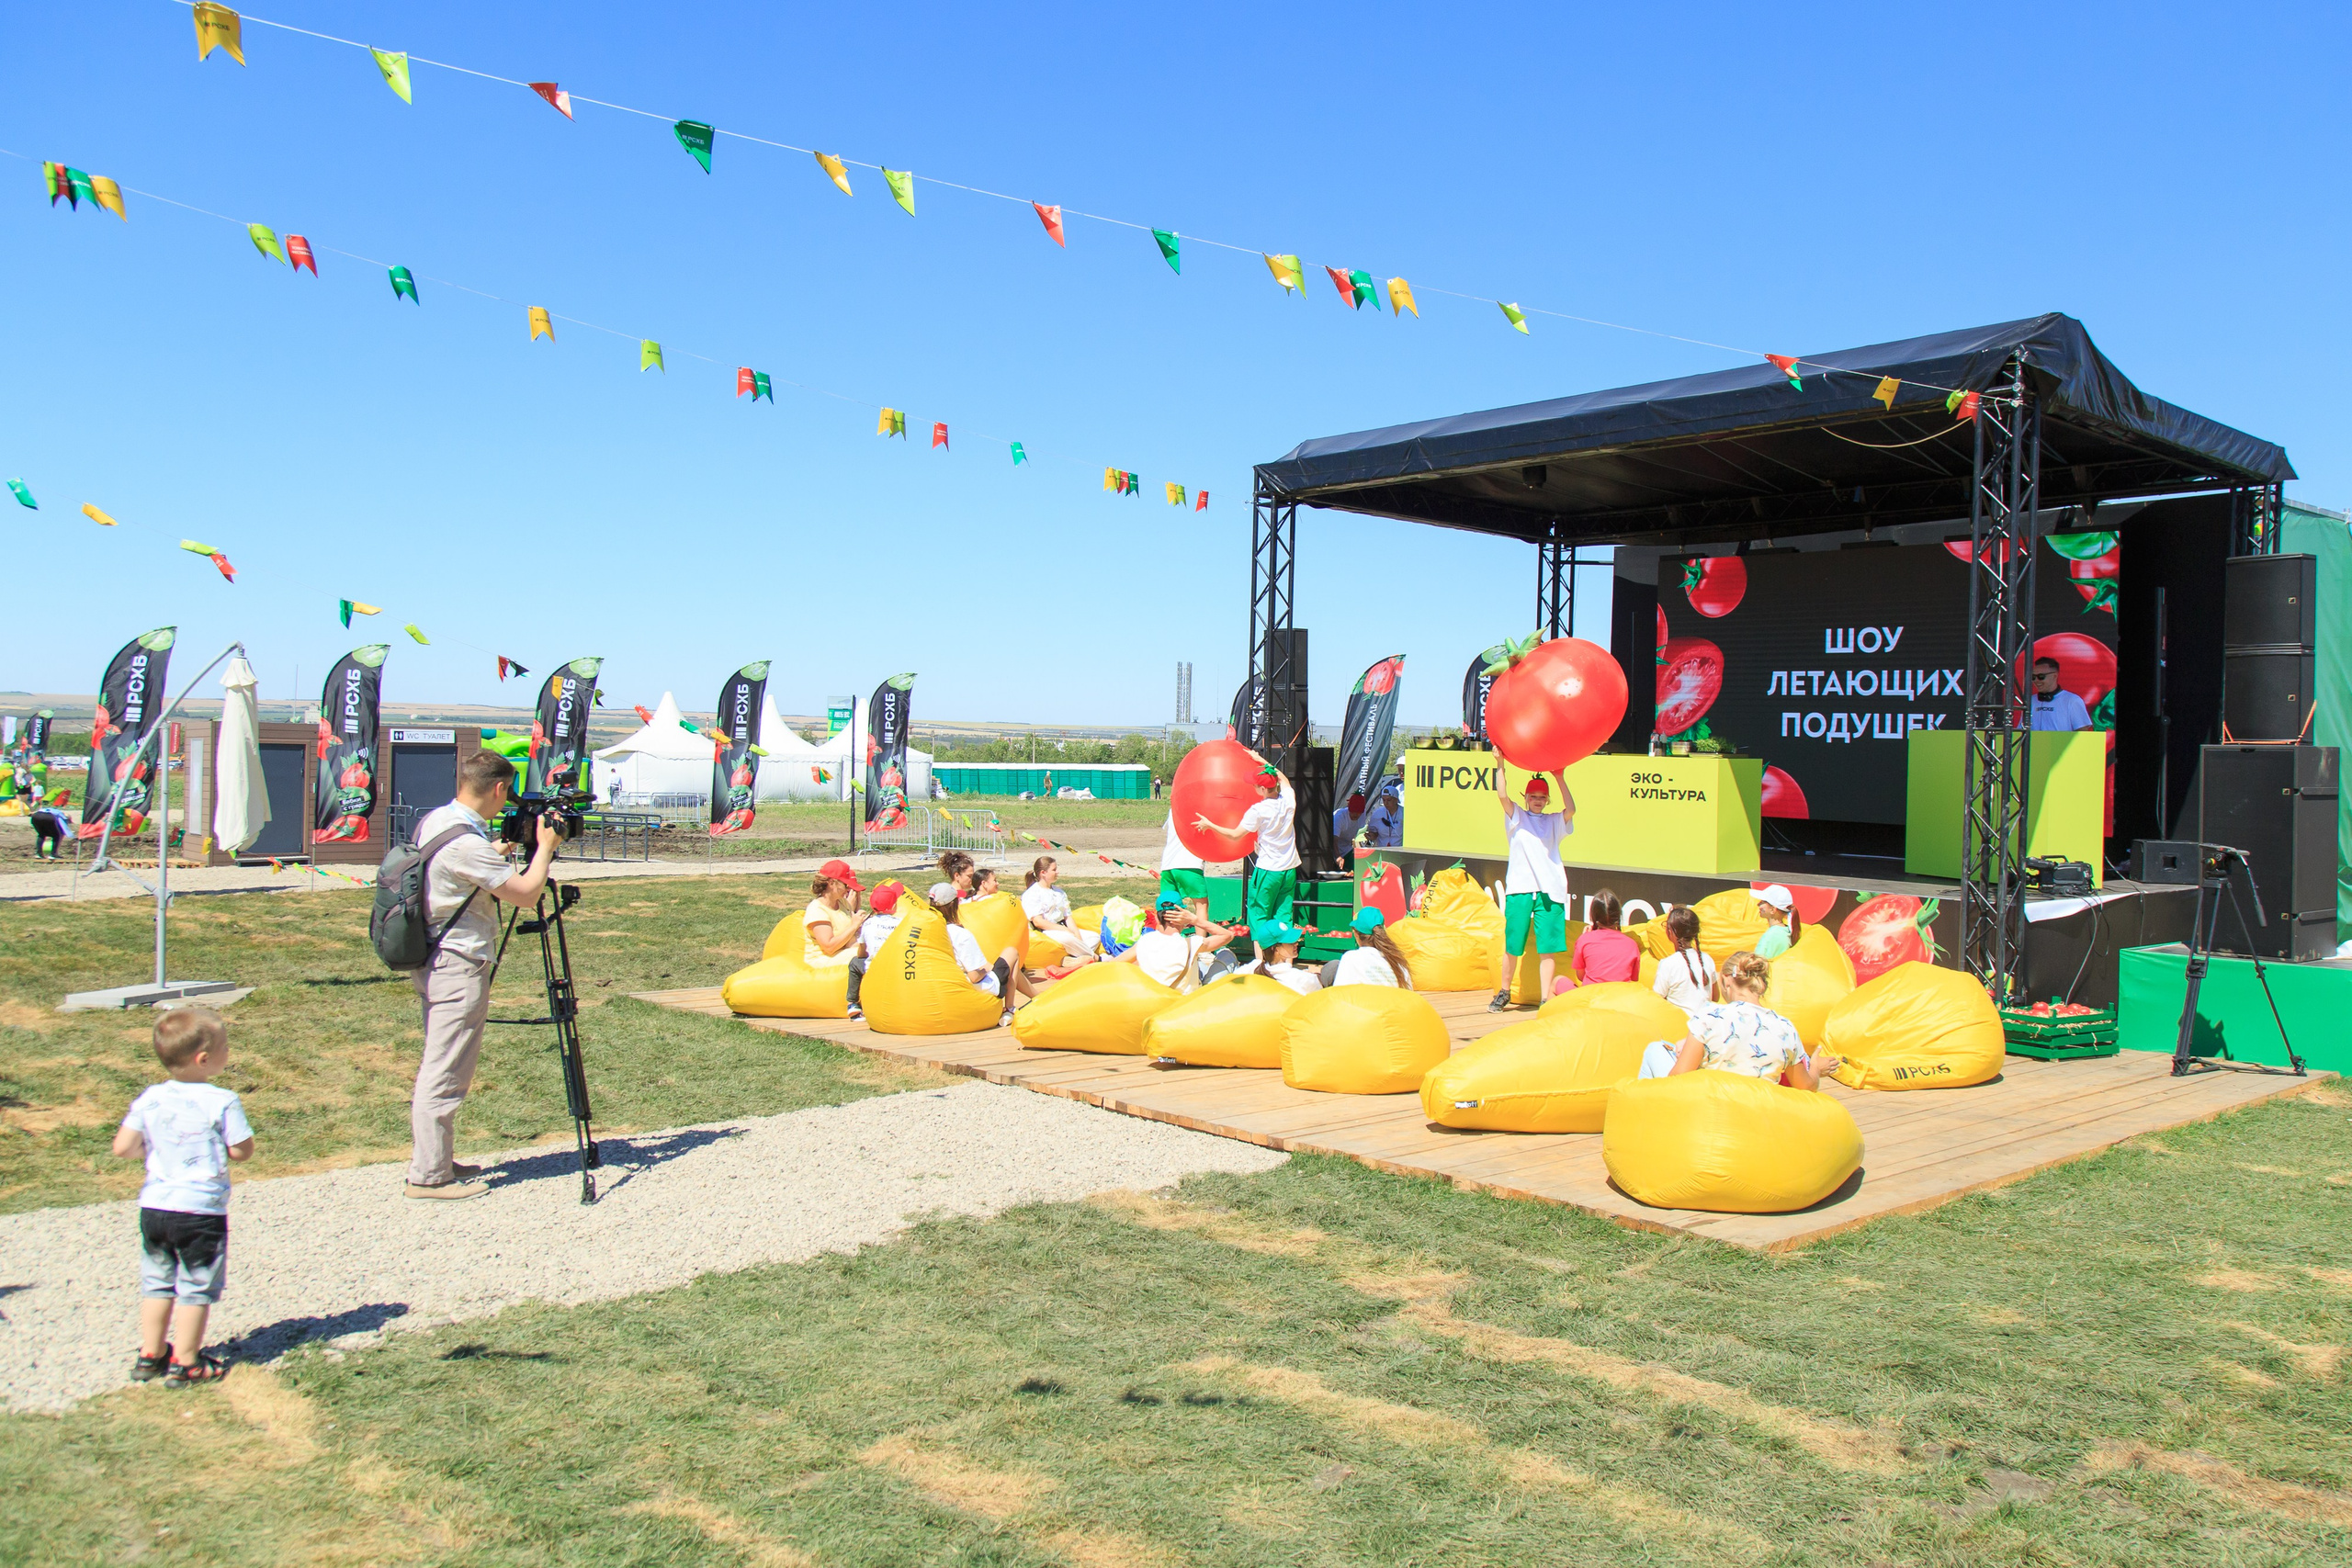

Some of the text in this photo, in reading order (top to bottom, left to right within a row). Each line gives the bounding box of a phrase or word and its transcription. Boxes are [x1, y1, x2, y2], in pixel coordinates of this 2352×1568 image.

[1825, 626, 1904, 653] ШОУ
[127, 654, 148, 705] РСХБ
[345, 669, 361, 716] РСХБ
[1767, 669, 1965, 701] ЛЕТАЮЩИХ
[558, 678, 577, 723] РСХБ
[736, 683, 749, 727] РСХБ
[884, 693, 896, 730] РСХБ
[1364, 704, 1377, 754] ФЕСТИВАЛЬ
[1781, 712, 1947, 743] ПОДУШЕК
[1630, 788, 1706, 802] КУЛЬТУРА
[1631, 773, 1662, 784] ЭКО
[905, 894, 920, 907] РС
[904, 941, 917, 981] РСХБ
